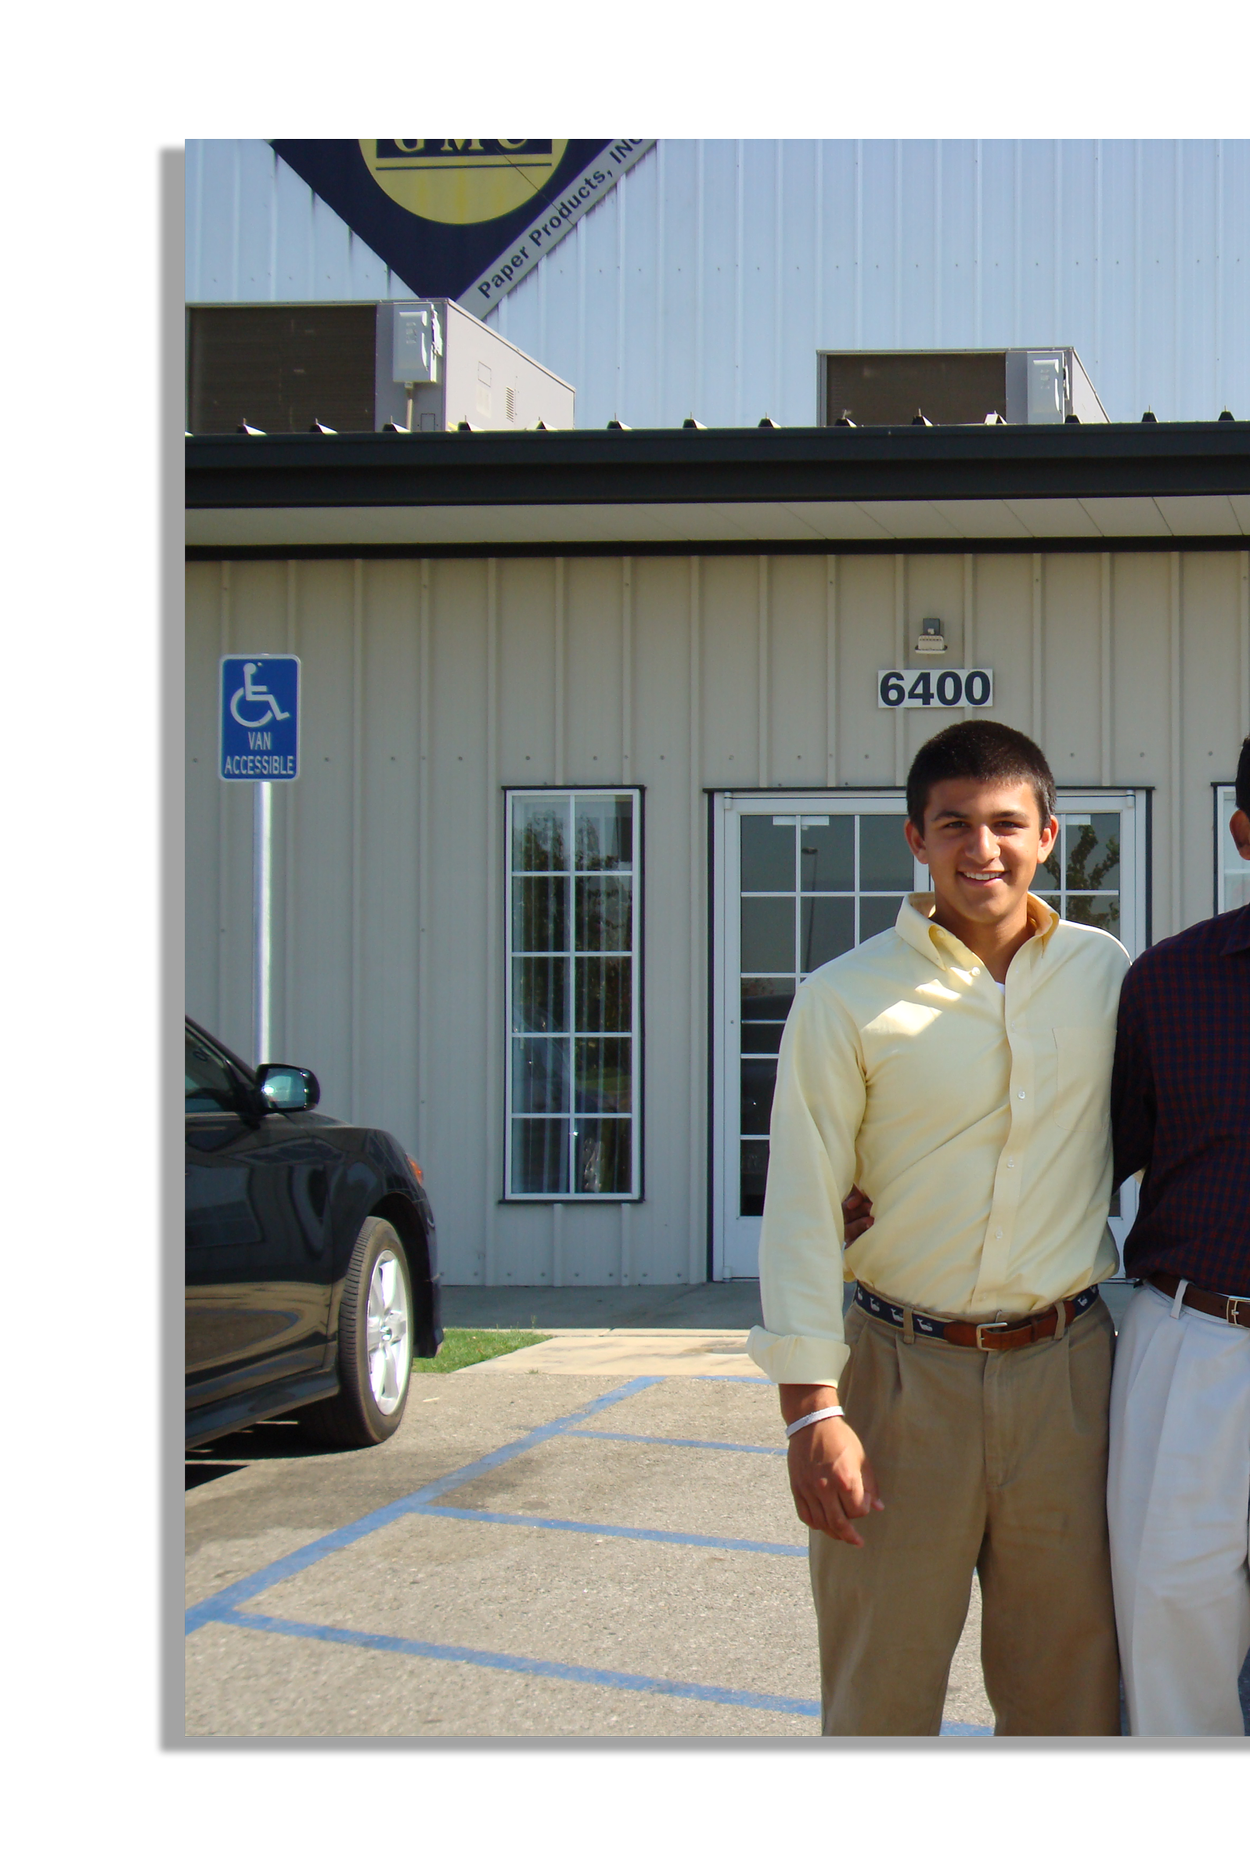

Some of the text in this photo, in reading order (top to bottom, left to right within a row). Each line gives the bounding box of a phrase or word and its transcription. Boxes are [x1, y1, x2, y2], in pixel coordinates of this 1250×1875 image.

[478, 246, 529, 299] Paper
[528, 169, 613, 247] Products,
[880, 671, 991, 707] 6400
[248, 731, 271, 750] VAN
[224, 755, 294, 775] ACCESSIBLE
